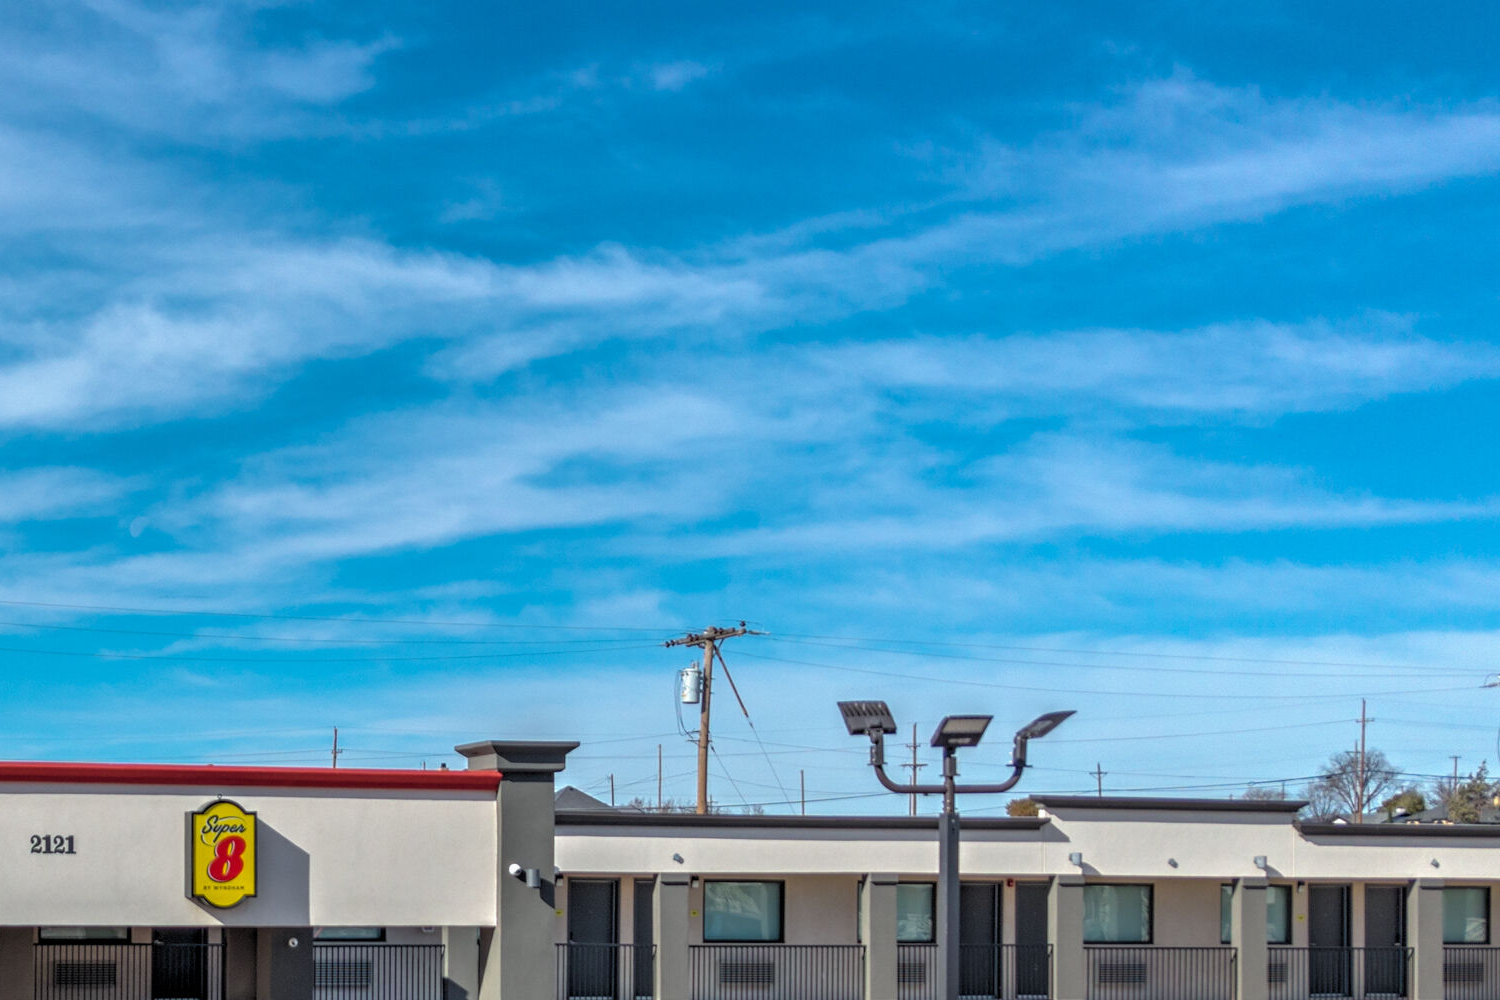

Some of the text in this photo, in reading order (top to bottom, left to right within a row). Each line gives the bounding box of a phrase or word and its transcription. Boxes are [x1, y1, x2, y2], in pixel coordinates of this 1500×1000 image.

[201, 814, 246, 843] Super
[30, 834, 76, 855] 2121
[207, 835, 246, 883] 8
